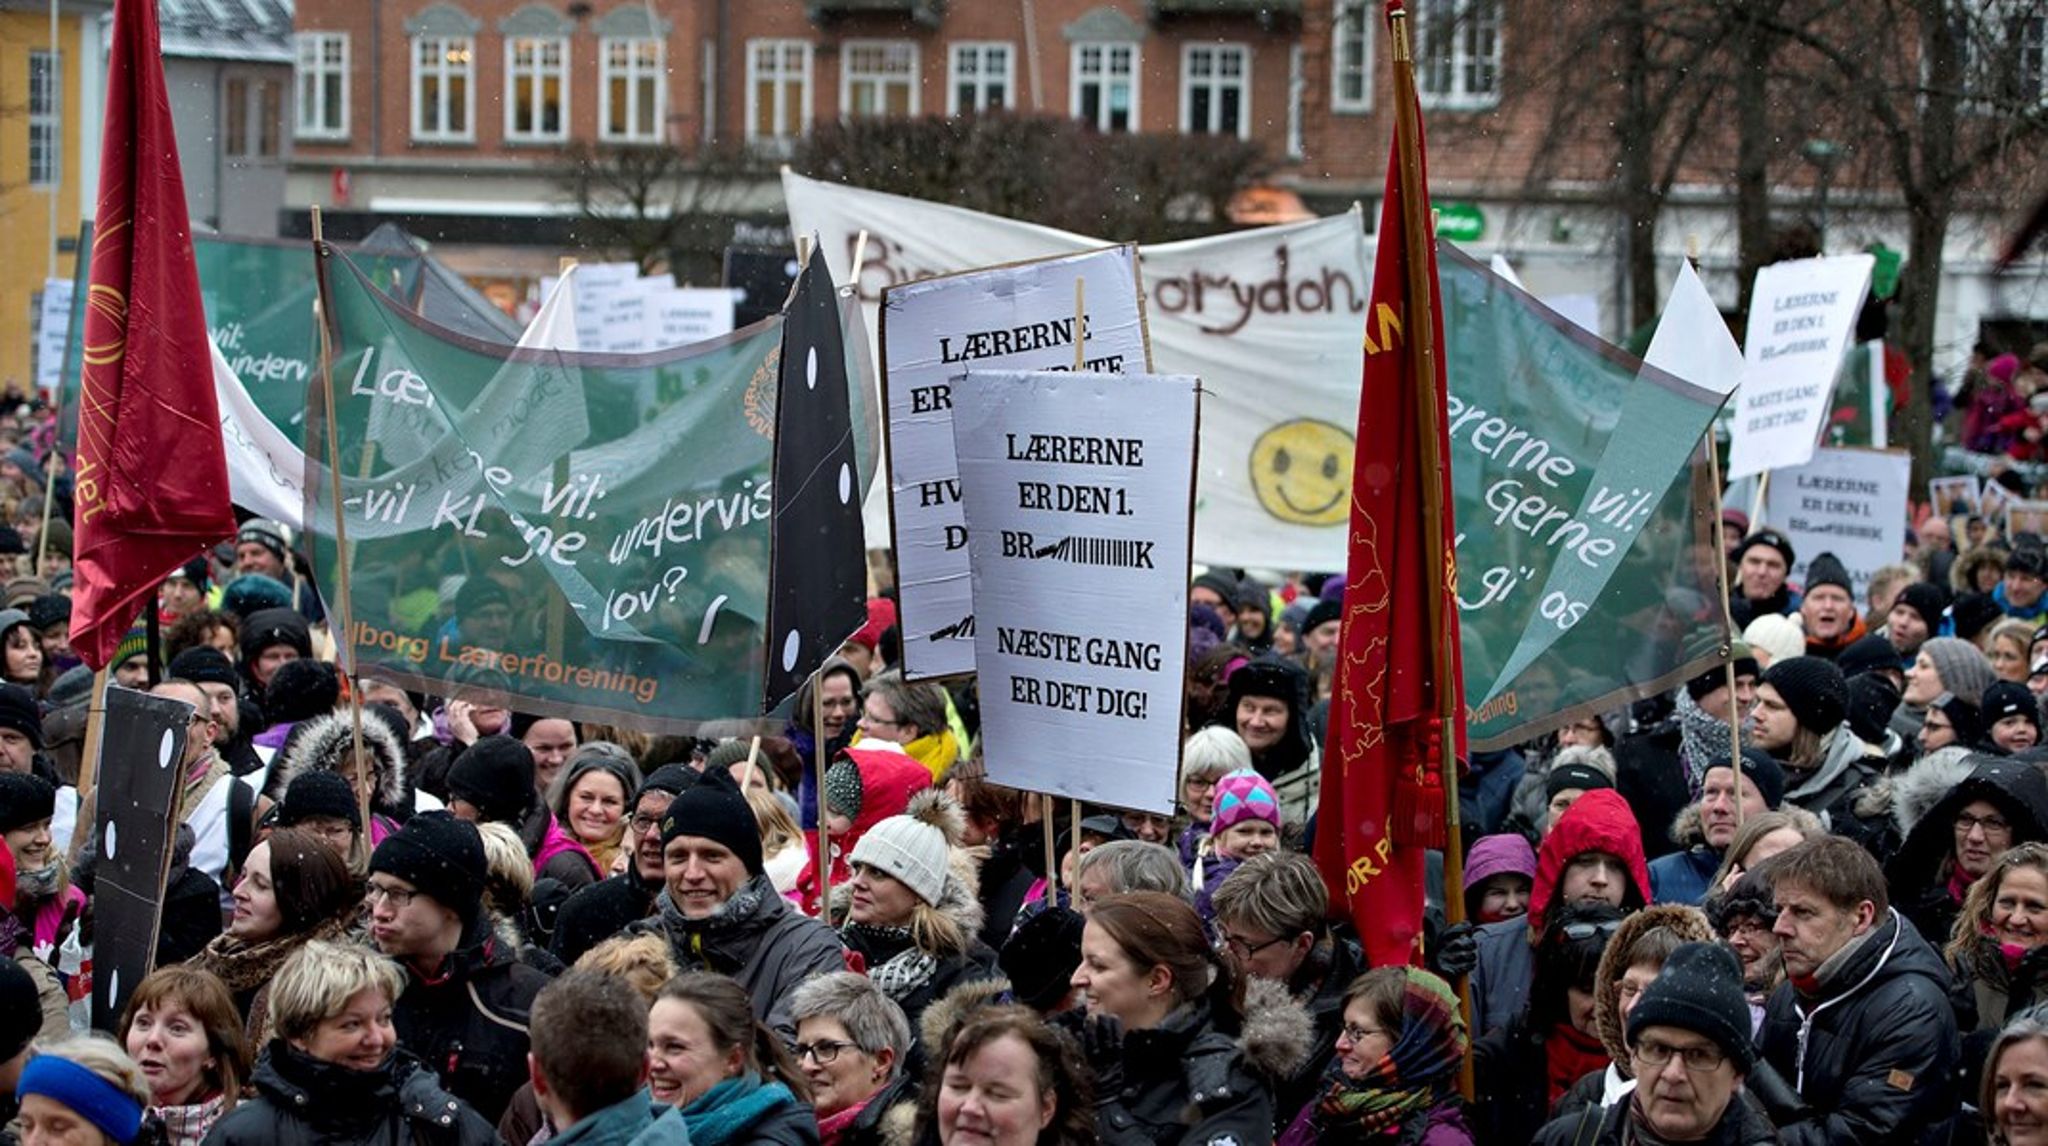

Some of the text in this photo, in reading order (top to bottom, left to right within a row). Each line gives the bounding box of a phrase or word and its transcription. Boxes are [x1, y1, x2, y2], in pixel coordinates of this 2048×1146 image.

[1144, 245, 1365, 335] orydon
[940, 315, 1091, 363] LÆRERNE
[911, 384, 952, 414] ER
[1006, 434, 1143, 467] LÆRERNE
[541, 474, 606, 520] vil:
[1018, 482, 1134, 516] ER DEN 1.
[1797, 474, 1880, 495] LÆRERNE
[431, 490, 488, 539] KL
[1485, 479, 1616, 568] Gerne
[1587, 486, 1653, 532] vil:
[603, 566, 688, 631] lov?
[1541, 590, 1589, 630] os
[353, 621, 658, 702] lborg Lærerforening
[997, 627, 1161, 672] NÆSTE GANG
[1011, 675, 1148, 719] ER DET DIG!
